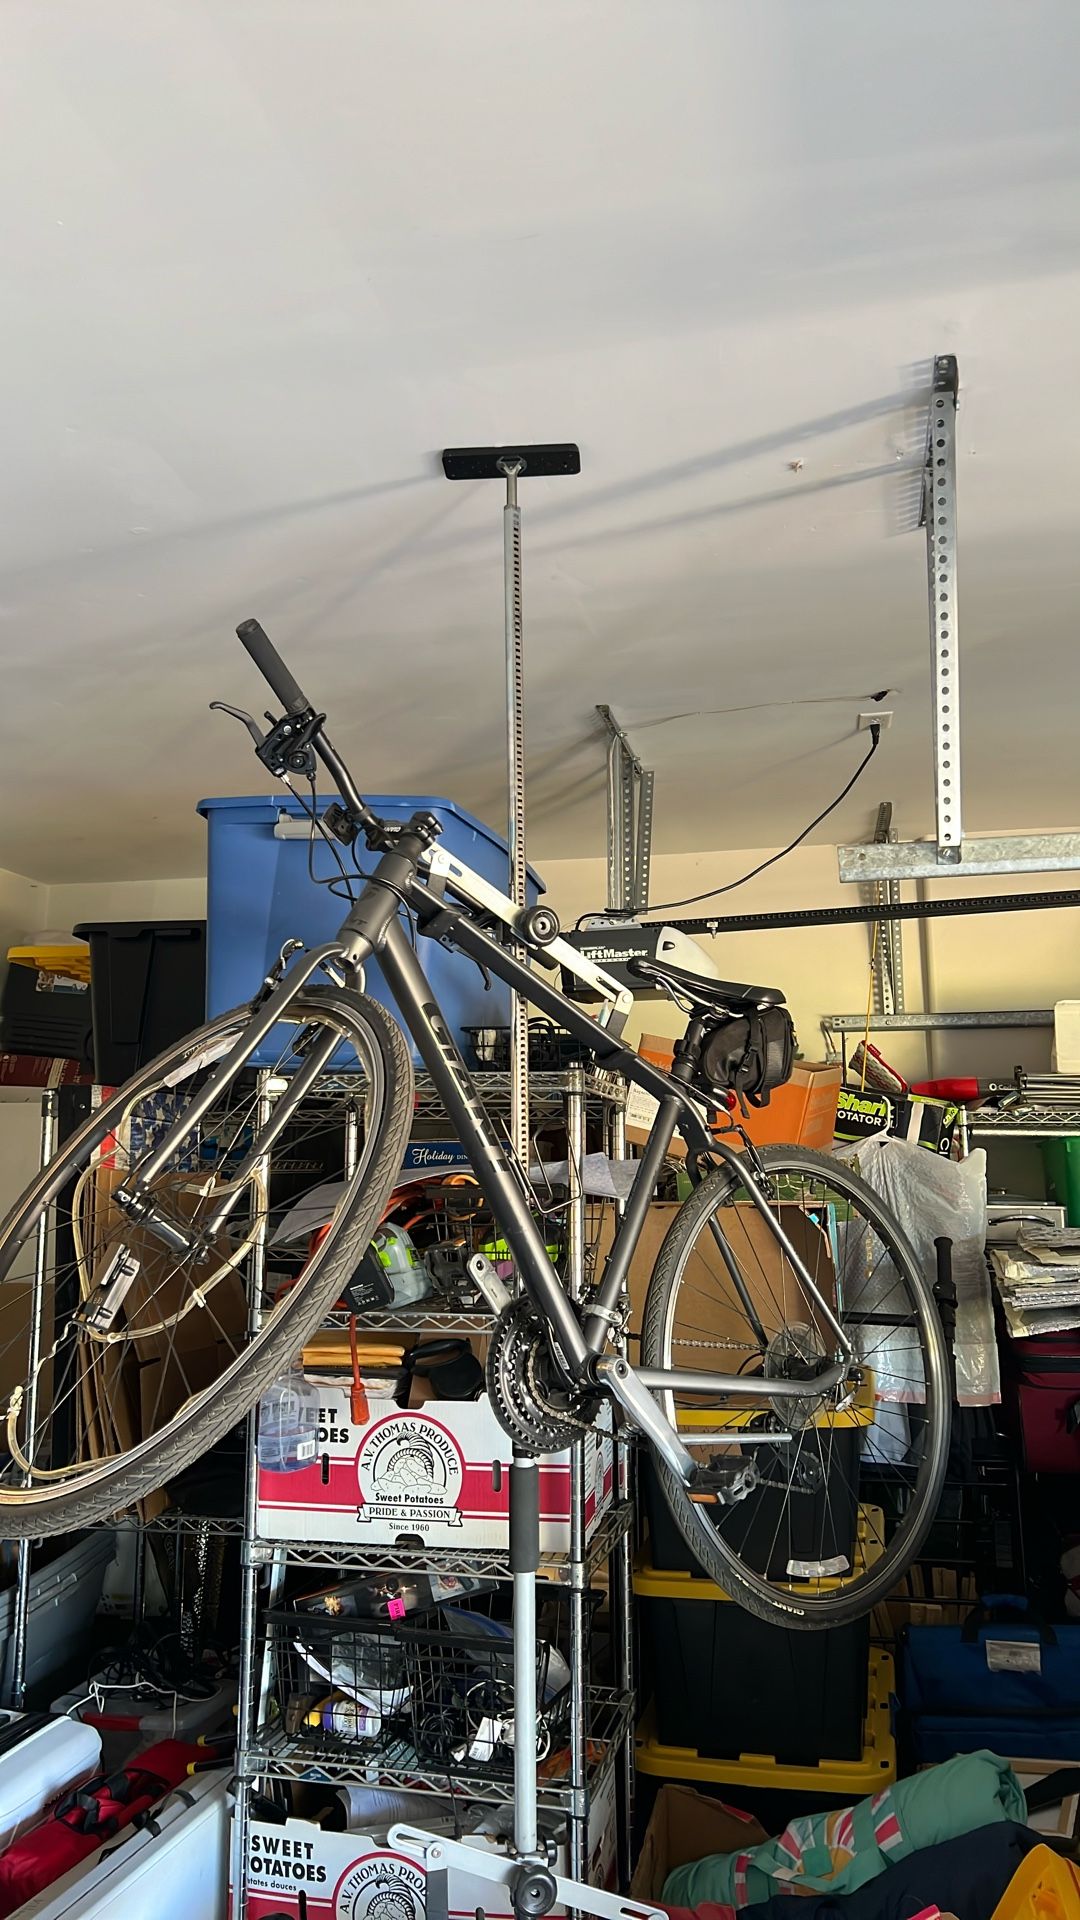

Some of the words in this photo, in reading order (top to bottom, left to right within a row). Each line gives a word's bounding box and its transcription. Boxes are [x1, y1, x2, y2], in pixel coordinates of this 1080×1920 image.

[837, 1091, 895, 1117] Shark
[836, 1110, 882, 1127] OTATOR
[411, 1147, 454, 1164] Holiday
[369, 1422, 416, 1448] THOMAS
[419, 1424, 459, 1476] PRODUCE
[375, 1492, 401, 1503] Sweet
[404, 1493, 444, 1505] Potatoes
[369, 1507, 398, 1517] PRIDE
[401, 1508, 407, 1517] &
[409, 1508, 451, 1519] PASSION
[388, 1523, 409, 1531] Since
[412, 1524, 430, 1532] 1960
[251, 1835, 314, 1860] SWEET
[248, 1855, 327, 1882] OTATOES
[270, 1880, 297, 1891] douces
[349, 1862, 395, 1891] THOMAS
[398, 1865, 426, 1897] PROD
